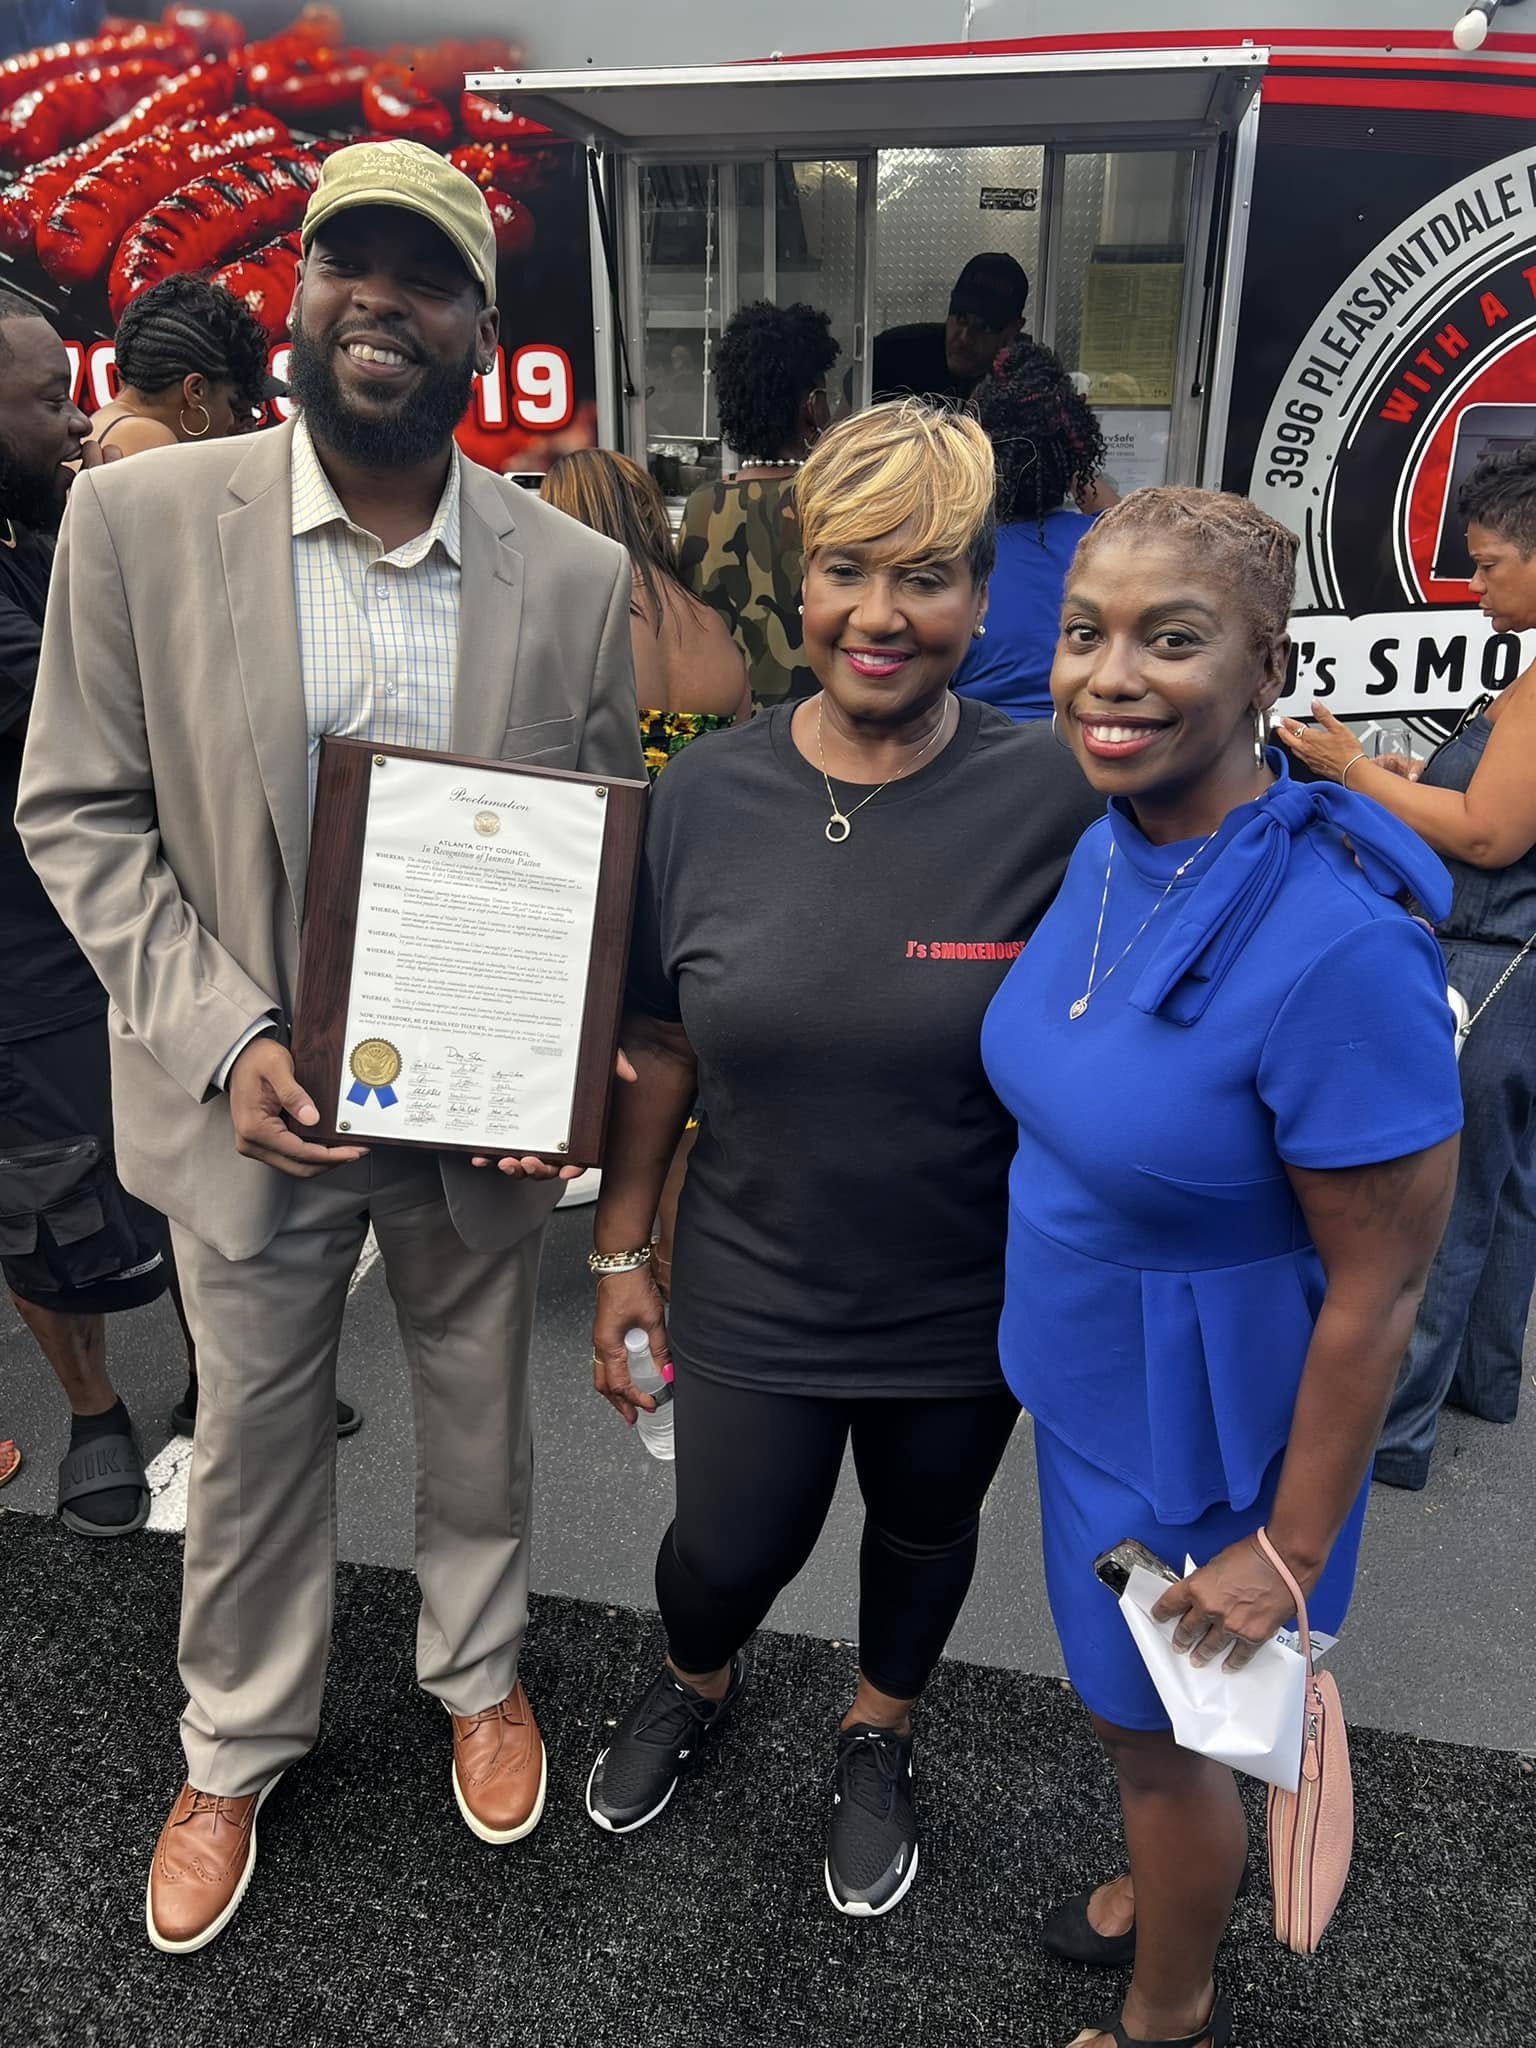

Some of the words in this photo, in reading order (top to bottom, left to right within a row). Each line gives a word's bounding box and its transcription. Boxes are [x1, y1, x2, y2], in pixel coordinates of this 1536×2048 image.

[1265, 399, 1323, 488] 3996
[1297, 174, 1522, 397] PLEASANTDALE
[1379, 324, 1469, 424] WITH
[1479, 291, 1508, 327] A
[449, 787, 529, 812] Proclamation
[422, 845, 431, 853] In
[439, 840, 473, 850] ATLANTA
[476, 845, 493, 853] CITY
[496, 847, 531, 857] COUNCIL
[905, 940, 928, 959] J's
